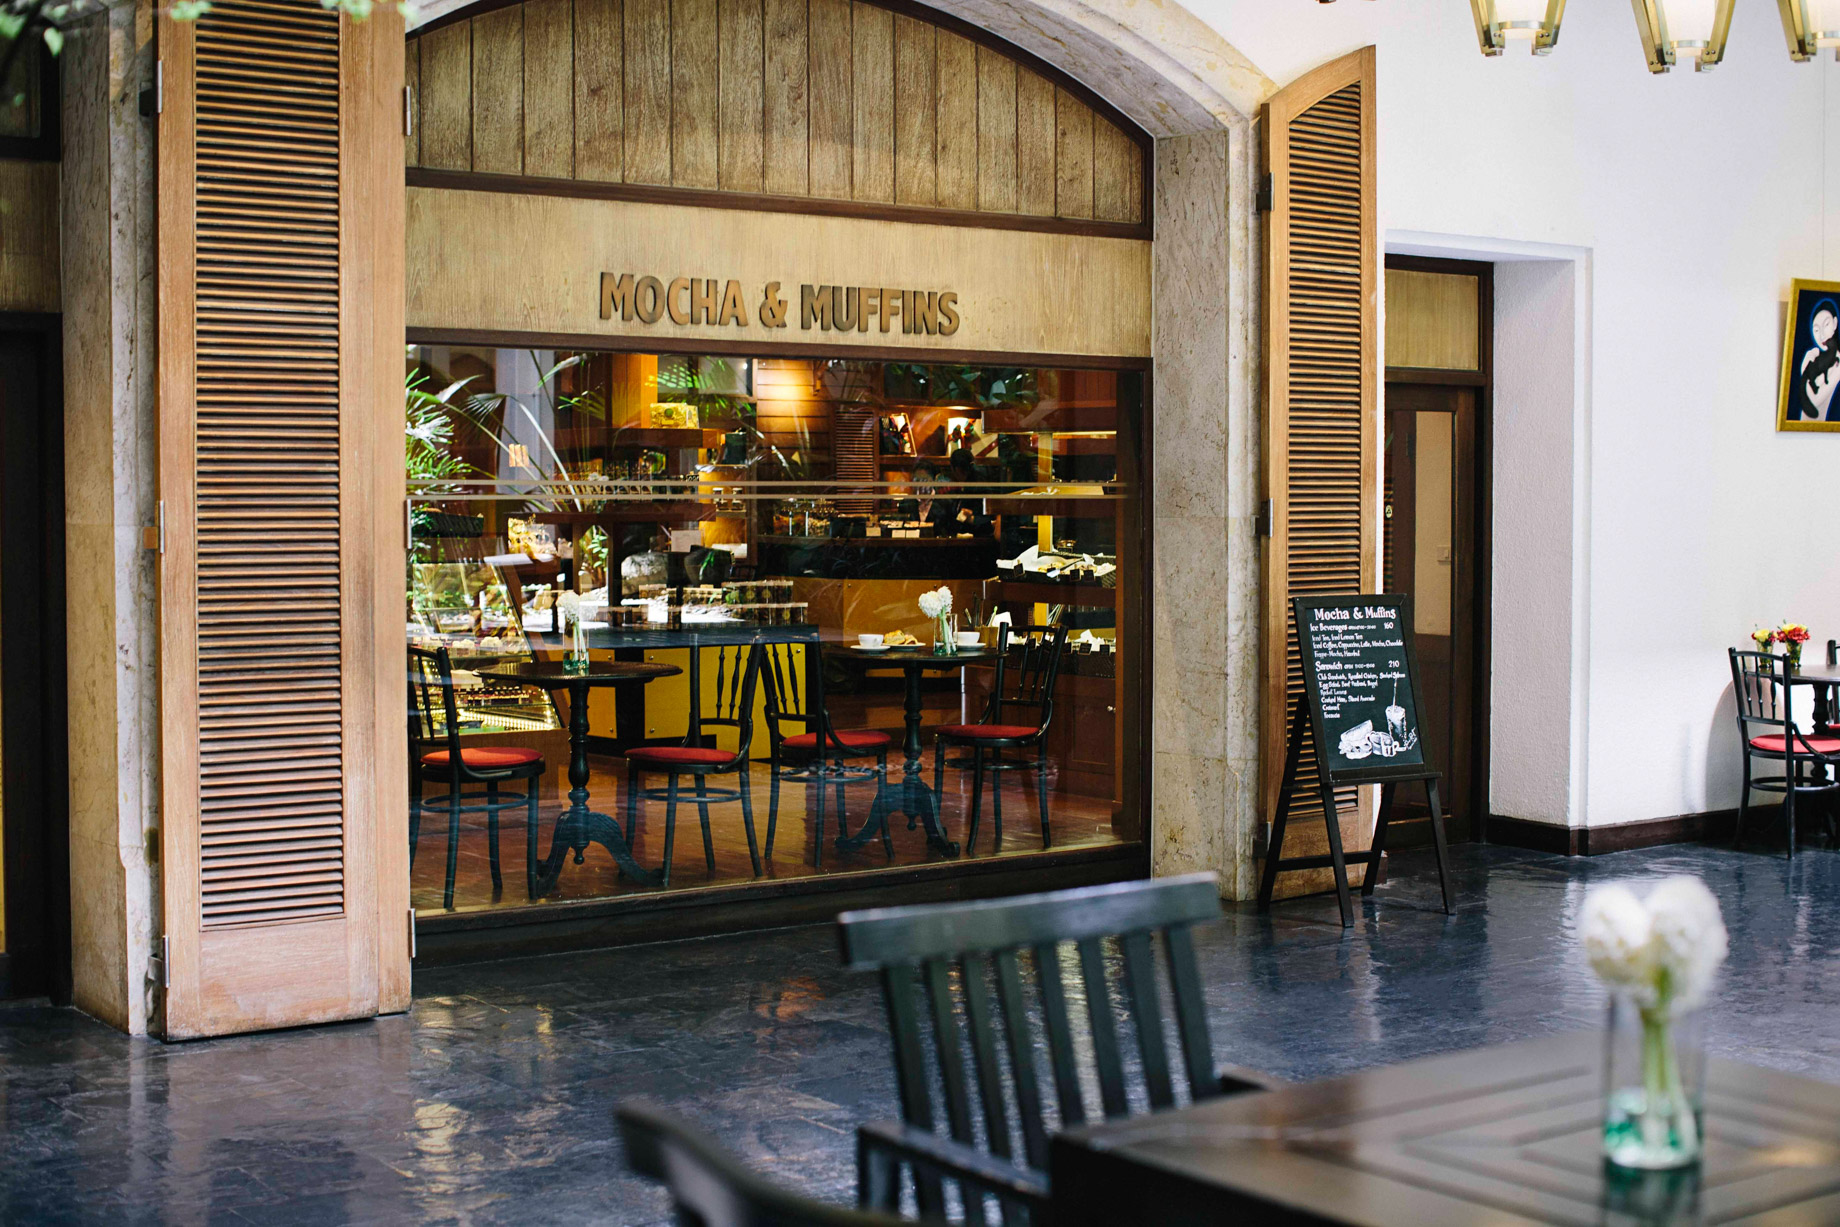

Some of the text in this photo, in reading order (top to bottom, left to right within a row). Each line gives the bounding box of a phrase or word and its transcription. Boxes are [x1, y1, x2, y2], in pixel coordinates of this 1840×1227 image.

[600, 272, 960, 336] MOCHA & MUFFINS
[1314, 606, 1396, 621] Mocha & Muffins
[1310, 623, 1318, 632] Ice
[1319, 623, 1347, 633] Beverages
[1384, 622, 1394, 630] 160
[1315, 661, 1342, 672] Sandwich
[1388, 660, 1400, 668] 210
